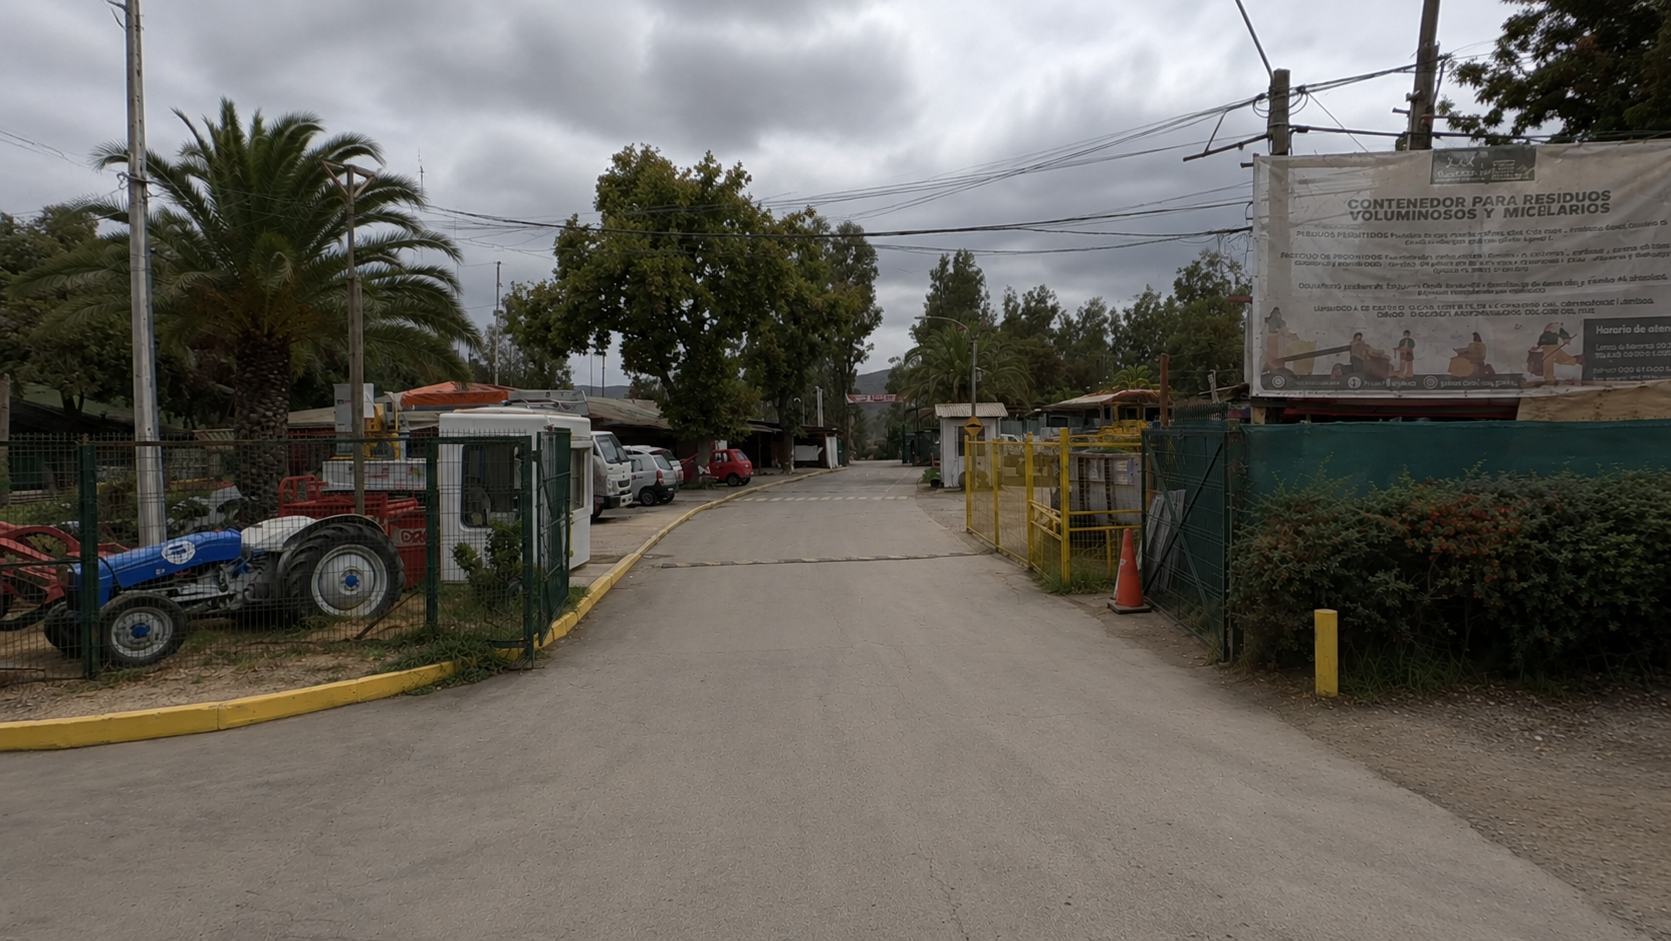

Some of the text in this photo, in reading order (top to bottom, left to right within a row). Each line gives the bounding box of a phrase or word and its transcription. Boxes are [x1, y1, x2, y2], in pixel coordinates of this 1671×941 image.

[1347, 190, 1612, 210] CONTENEDOR PARA RESIDUOS
[1349, 203, 1611, 221] VOLUMINOSOS Y MICELARIOS
[1595, 324, 1632, 334] Horario
[1633, 324, 1646, 333] de
